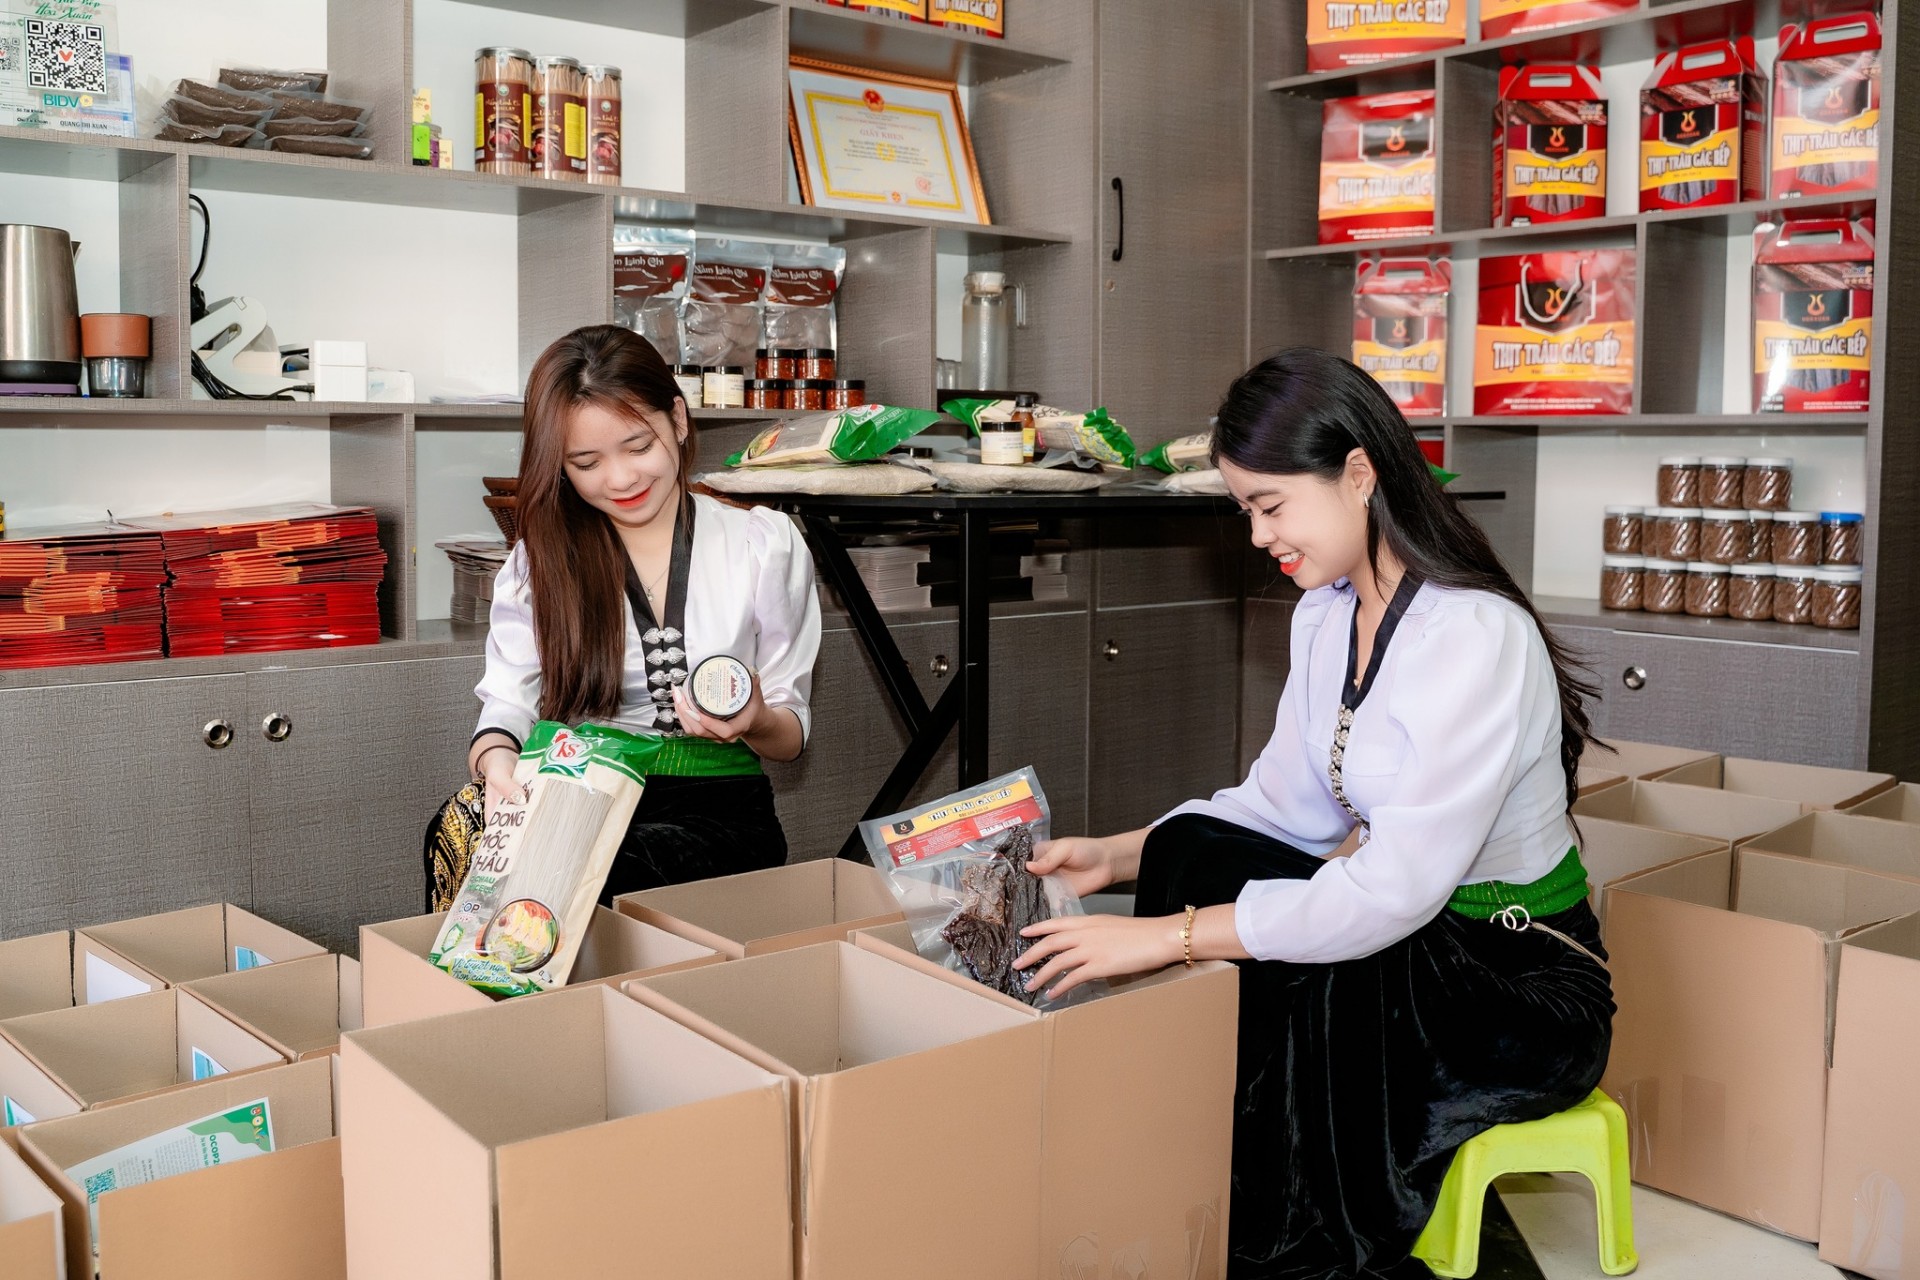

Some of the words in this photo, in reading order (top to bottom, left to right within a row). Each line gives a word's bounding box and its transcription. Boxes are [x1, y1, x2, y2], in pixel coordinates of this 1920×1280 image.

[43, 93, 79, 108] BIDV
[488, 811, 526, 827] DONG
[474, 851, 509, 873] HÂU
[209, 1134, 220, 1165] OCOP2
